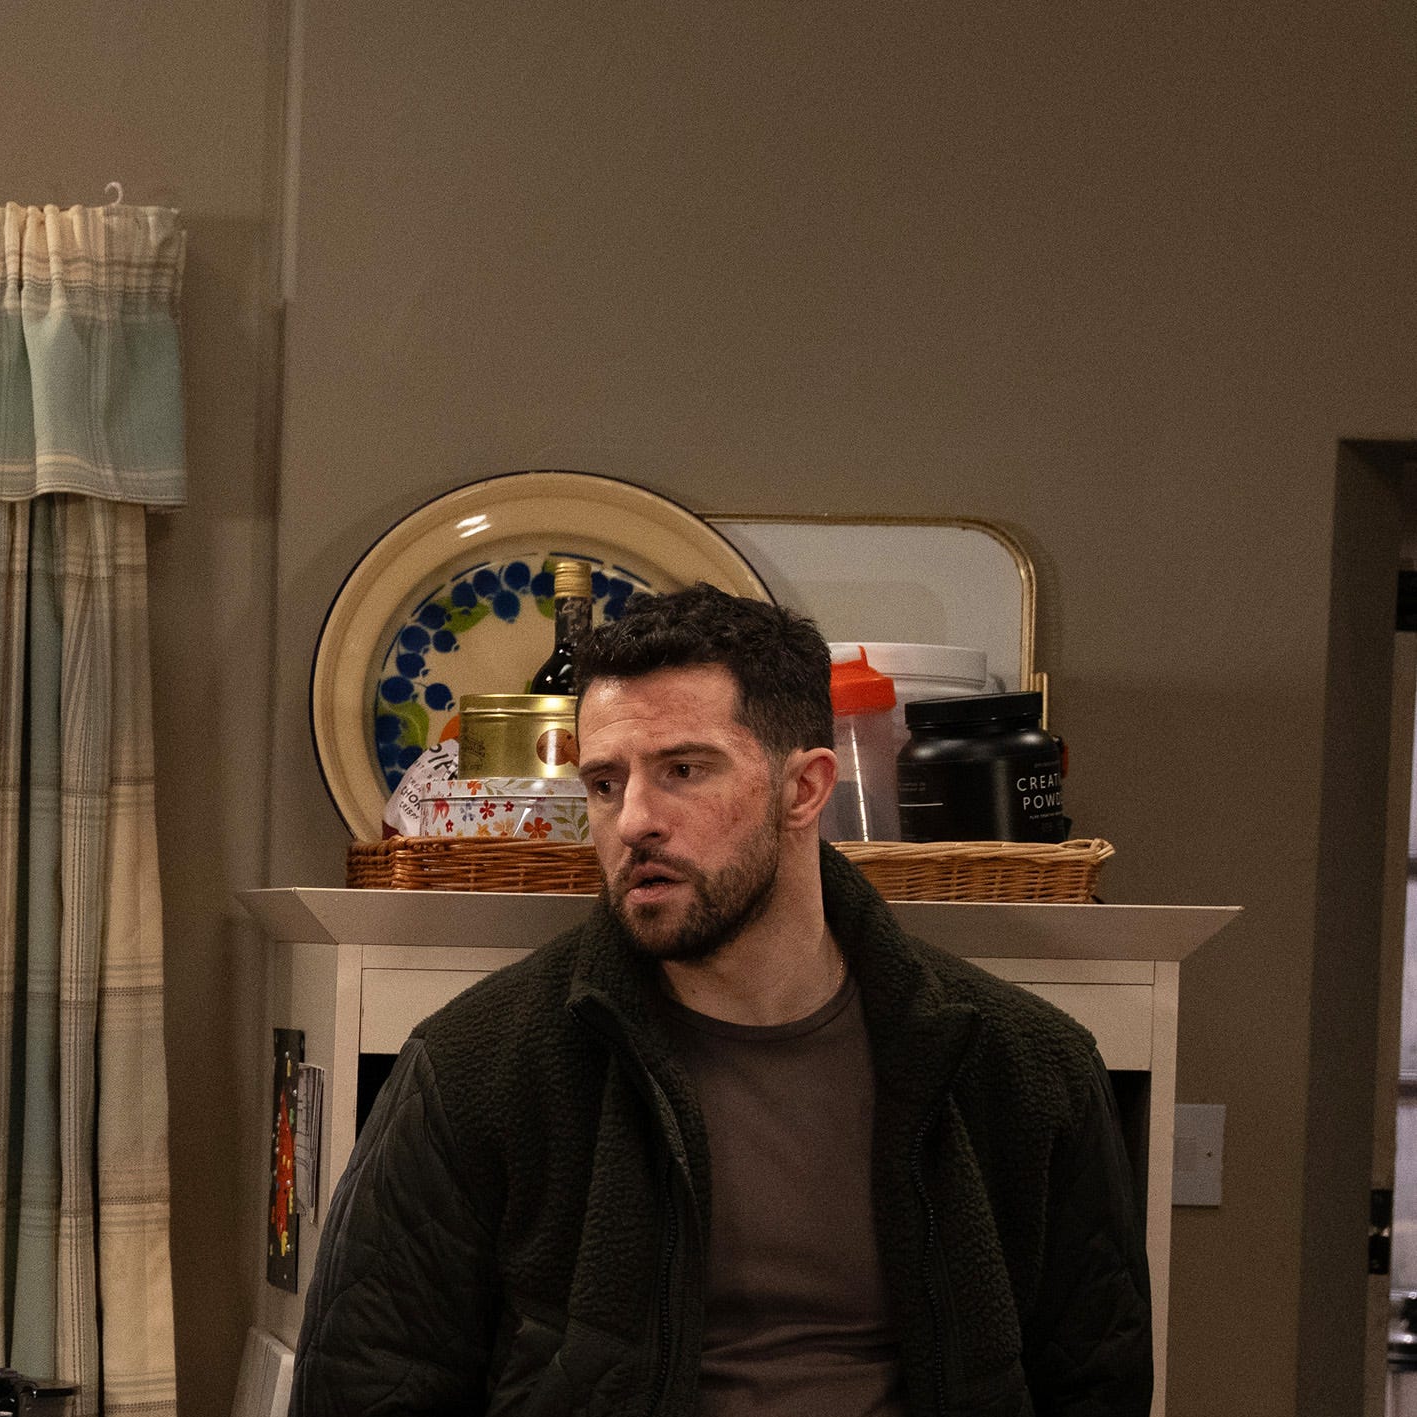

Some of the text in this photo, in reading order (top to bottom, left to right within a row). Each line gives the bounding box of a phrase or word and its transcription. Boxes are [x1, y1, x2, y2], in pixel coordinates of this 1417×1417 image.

[1016, 772, 1059, 792] CREAT
[400, 785, 421, 811] CHOR
[1023, 791, 1062, 811] POWD
